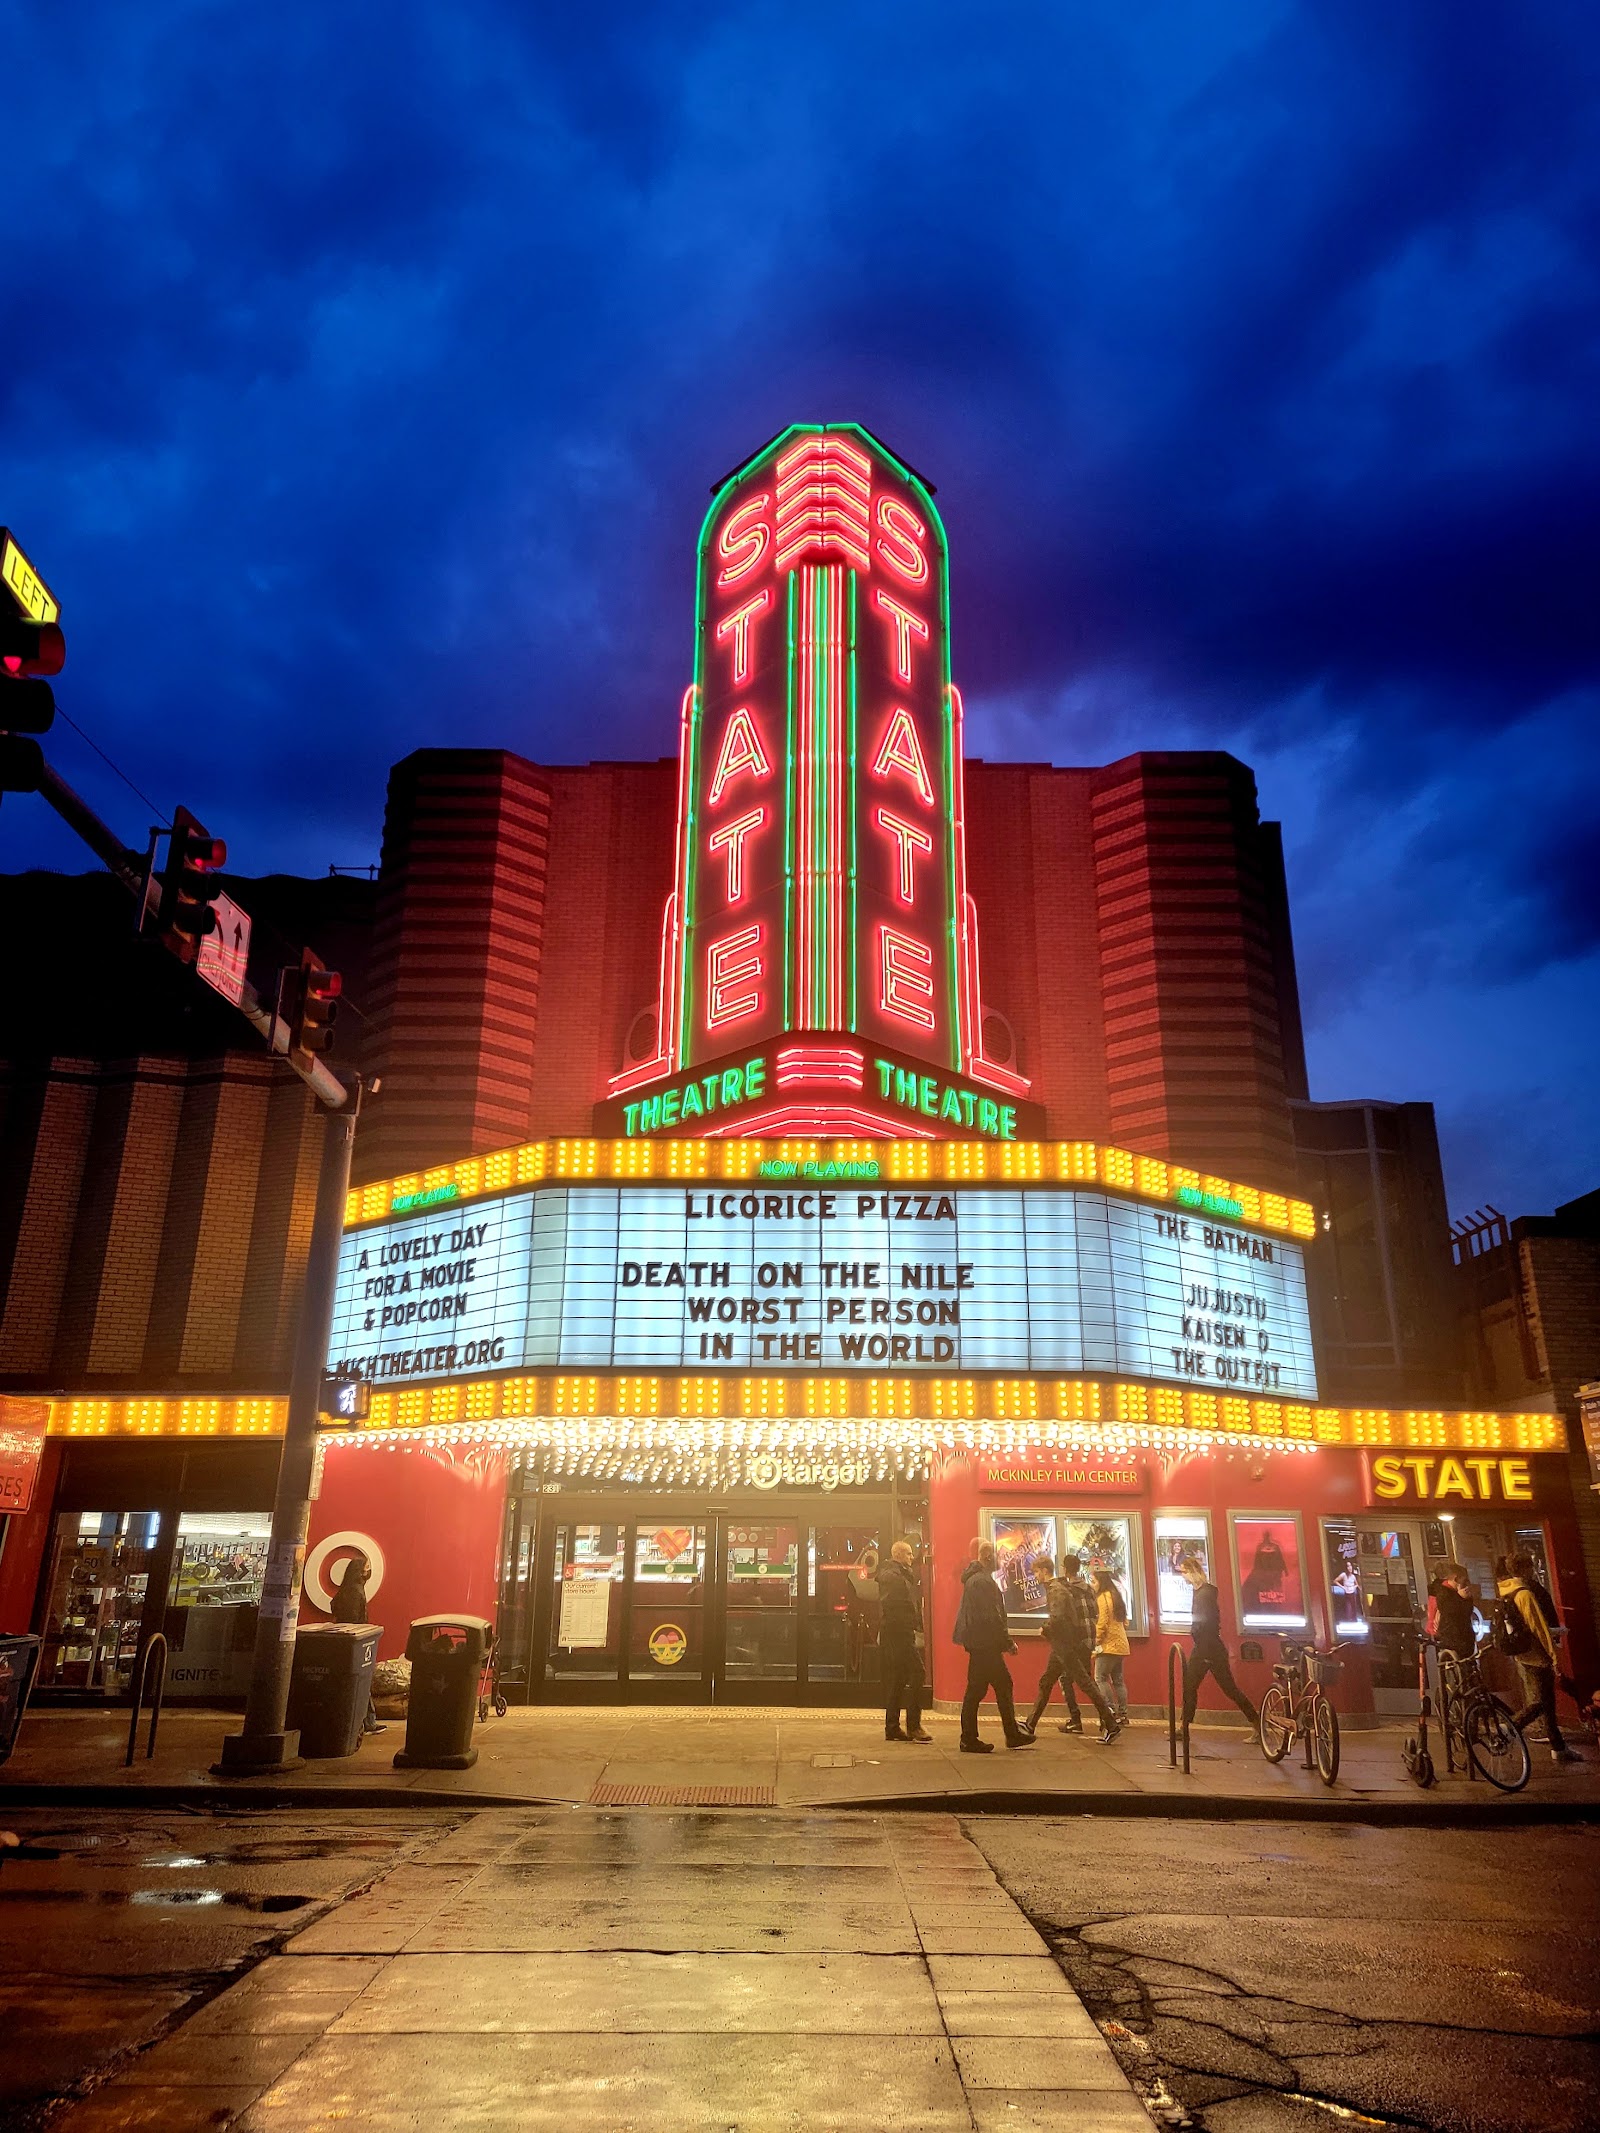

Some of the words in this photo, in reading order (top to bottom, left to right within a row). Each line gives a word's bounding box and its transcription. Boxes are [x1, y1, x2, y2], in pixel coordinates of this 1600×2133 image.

[10, 555, 49, 621] LEFT
[708, 493, 770, 1031] STATE
[874, 493, 936, 1031] STATE
[623, 1057, 767, 1137] THEATRE
[874, 1058, 1017, 1141] THEATRE
[759, 1160, 798, 1177] NOW
[803, 1160, 879, 1177] PLAYING
[391, 1194, 413, 1211] NOW
[413, 1183, 457, 1206] PLAYING
[686, 1194, 836, 1220] LICORICE
[858, 1195, 957, 1221] PIZZA
[358, 1249, 369, 1272] A
[380, 1233, 443, 1268] LOVELY
[450, 1223, 488, 1252] DAY
[1153, 1214, 1190, 1242] THE
[1203, 1225, 1274, 1265] BATMAN
[364, 1274, 394, 1300] FOR
[399, 1271, 412, 1295] A
[420, 1258, 477, 1290] MOVIE
[622, 1261, 730, 1288] DEATH
[757, 1262, 804, 1288] ON
[820, 1262, 880, 1289] THE
[901, 1263, 974, 1290] NILE
[363, 1307, 375, 1331] &
[381, 1292, 468, 1328] POPCORN
[688, 1296, 804, 1325] WORST
[826, 1299, 960, 1327] PERSON
[700, 1332, 734, 1361] IN
[757, 1333, 822, 1361] THE
[840, 1333, 955, 1363] WORLD
[1181, 1313, 1246, 1350] KAISEN
[1171, 1346, 1207, 1377] THE
[1215, 1353, 1281, 1389] OUTFIT
[786, 1459, 867, 1491] target
[988, 1468, 1052, 1483] MCKINLEY
[1056, 1469, 1086, 1483] FILM
[1089, 1470, 1138, 1485] CENTER
[1373, 1455, 1533, 1501] STATE
[1024, 1590, 1042, 1602] NILE
